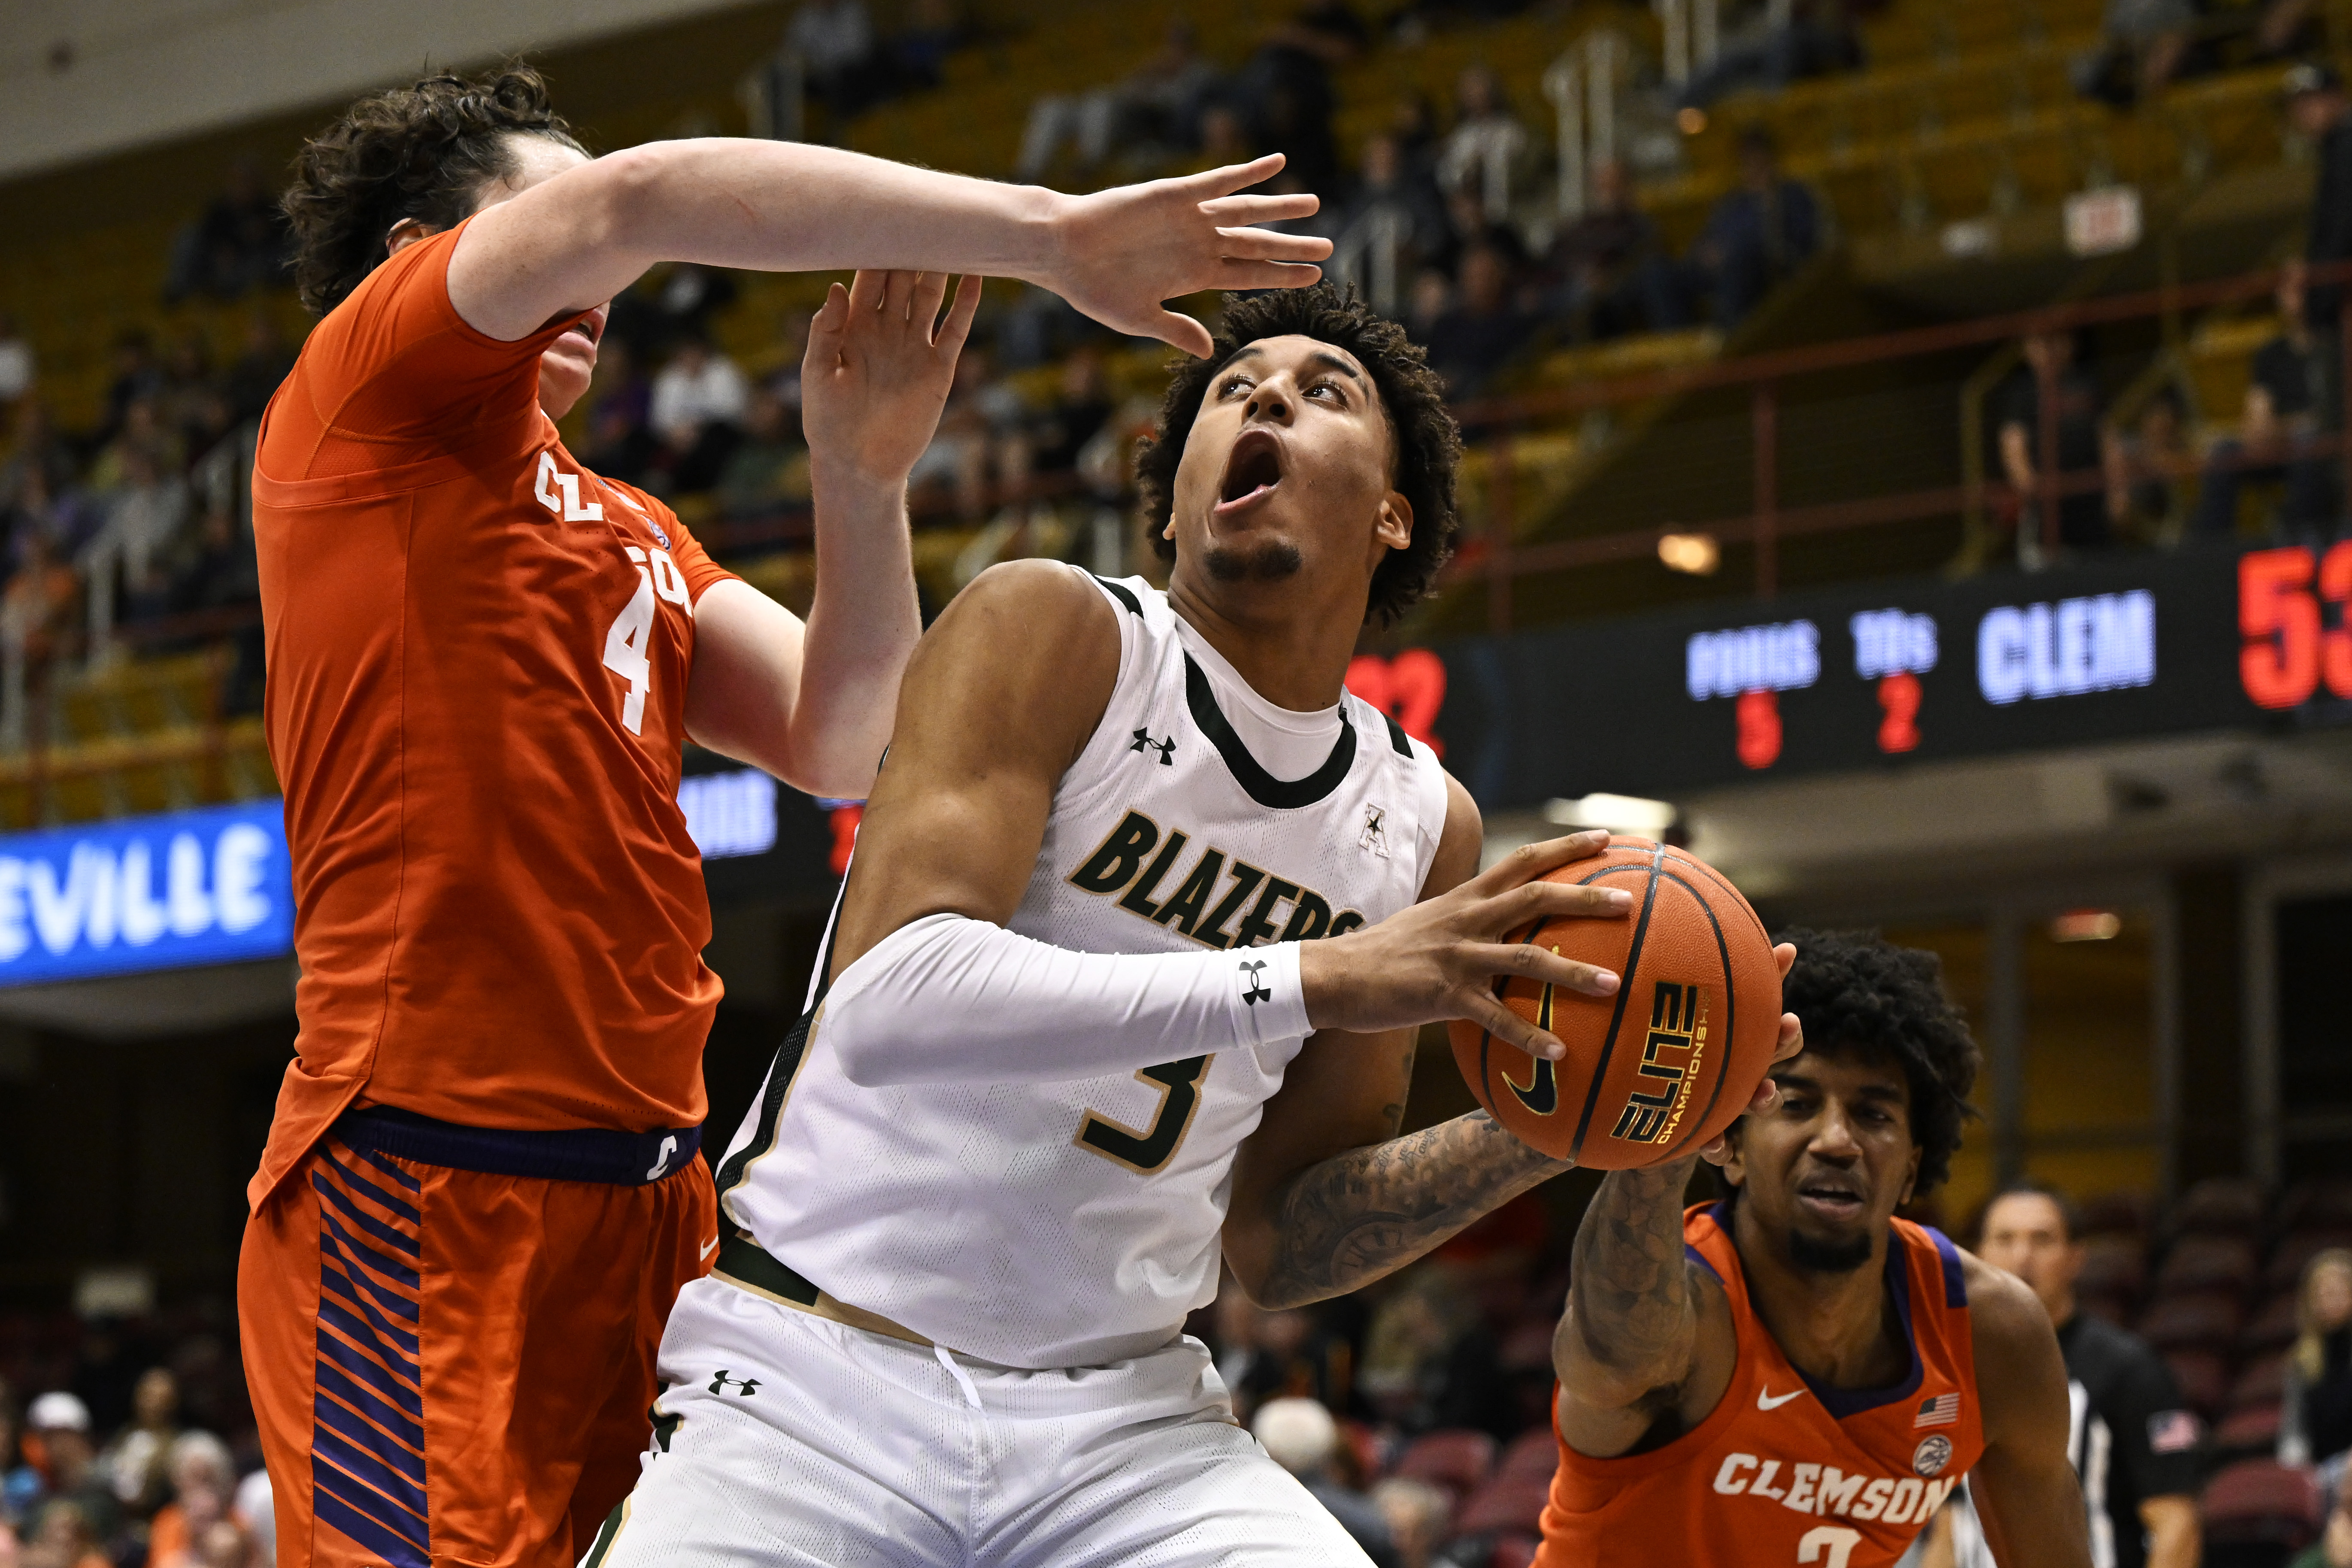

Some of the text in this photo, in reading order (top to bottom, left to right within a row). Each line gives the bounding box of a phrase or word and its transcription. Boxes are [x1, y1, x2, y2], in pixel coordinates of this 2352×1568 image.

[602, 575, 656, 737] 4
[1977, 589, 2156, 705] CLEM
[1071, 1052, 1216, 1176] 3
[1609, 980, 1698, 1144] ELITE
[1657, 986, 1711, 1145] CHAMPIONSH
[1713, 1452, 1956, 1525] CLEMSON
